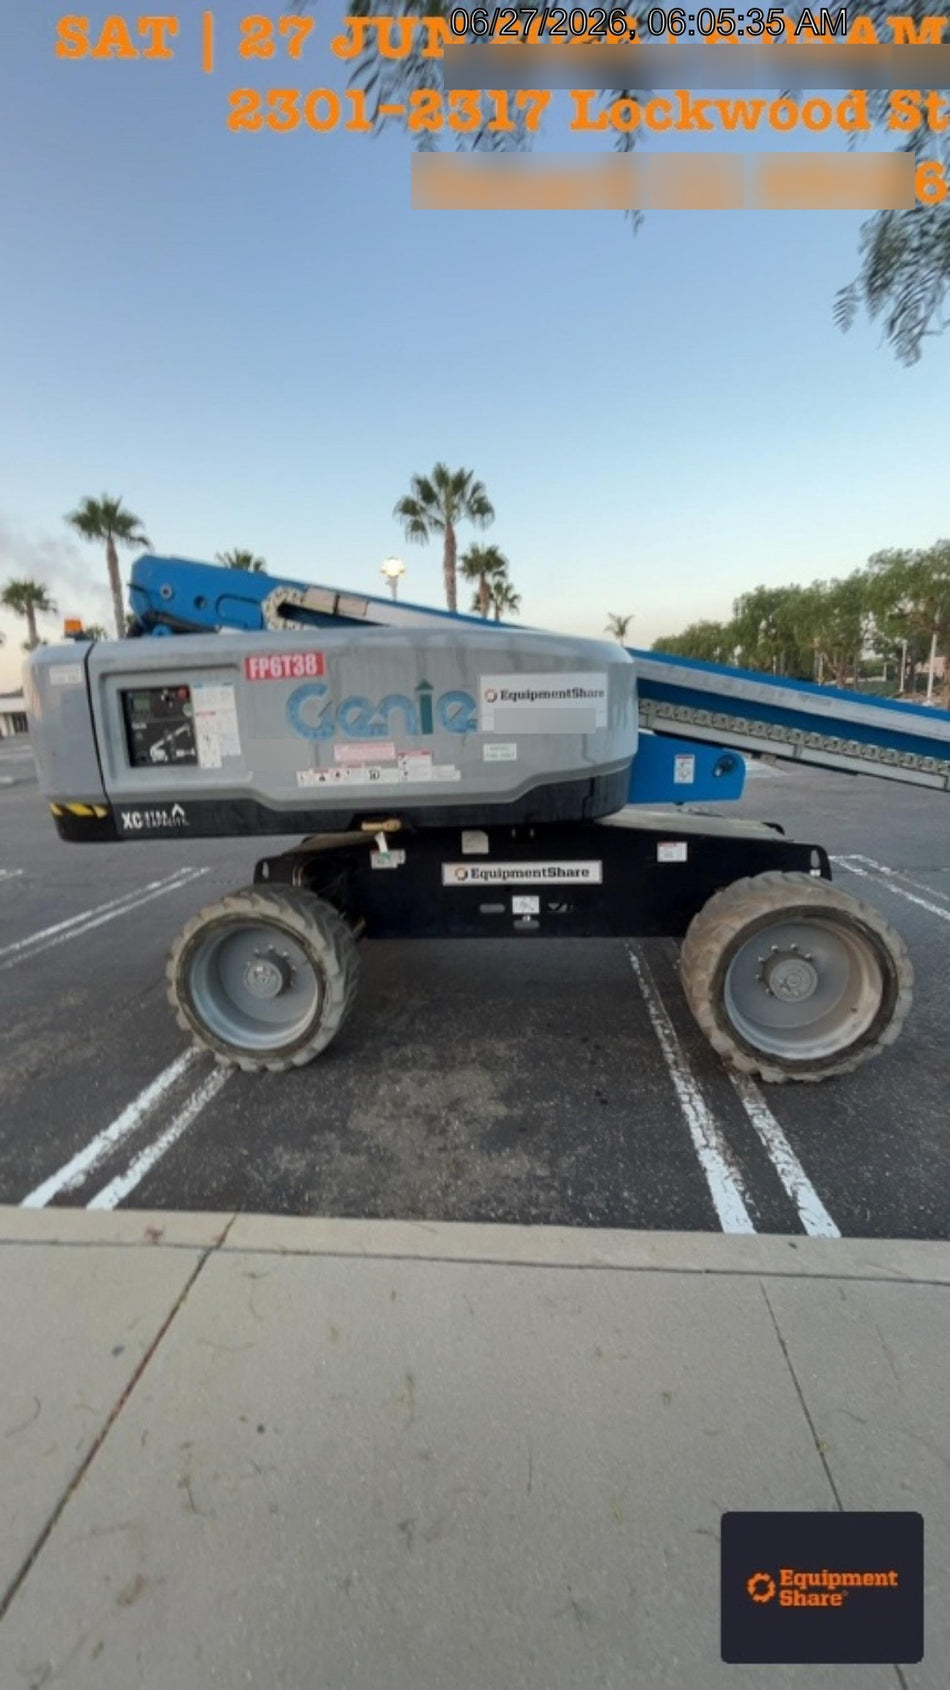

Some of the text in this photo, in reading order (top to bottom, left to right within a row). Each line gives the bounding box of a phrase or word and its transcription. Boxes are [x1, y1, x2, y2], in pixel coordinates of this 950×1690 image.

[249, 654, 318, 678] FP6T38
[500, 686, 605, 702] EquipmentShare
[286, 679, 478, 740] Genie
[121, 811, 143, 830] XC
[471, 866, 590, 881] EquipmentShare
